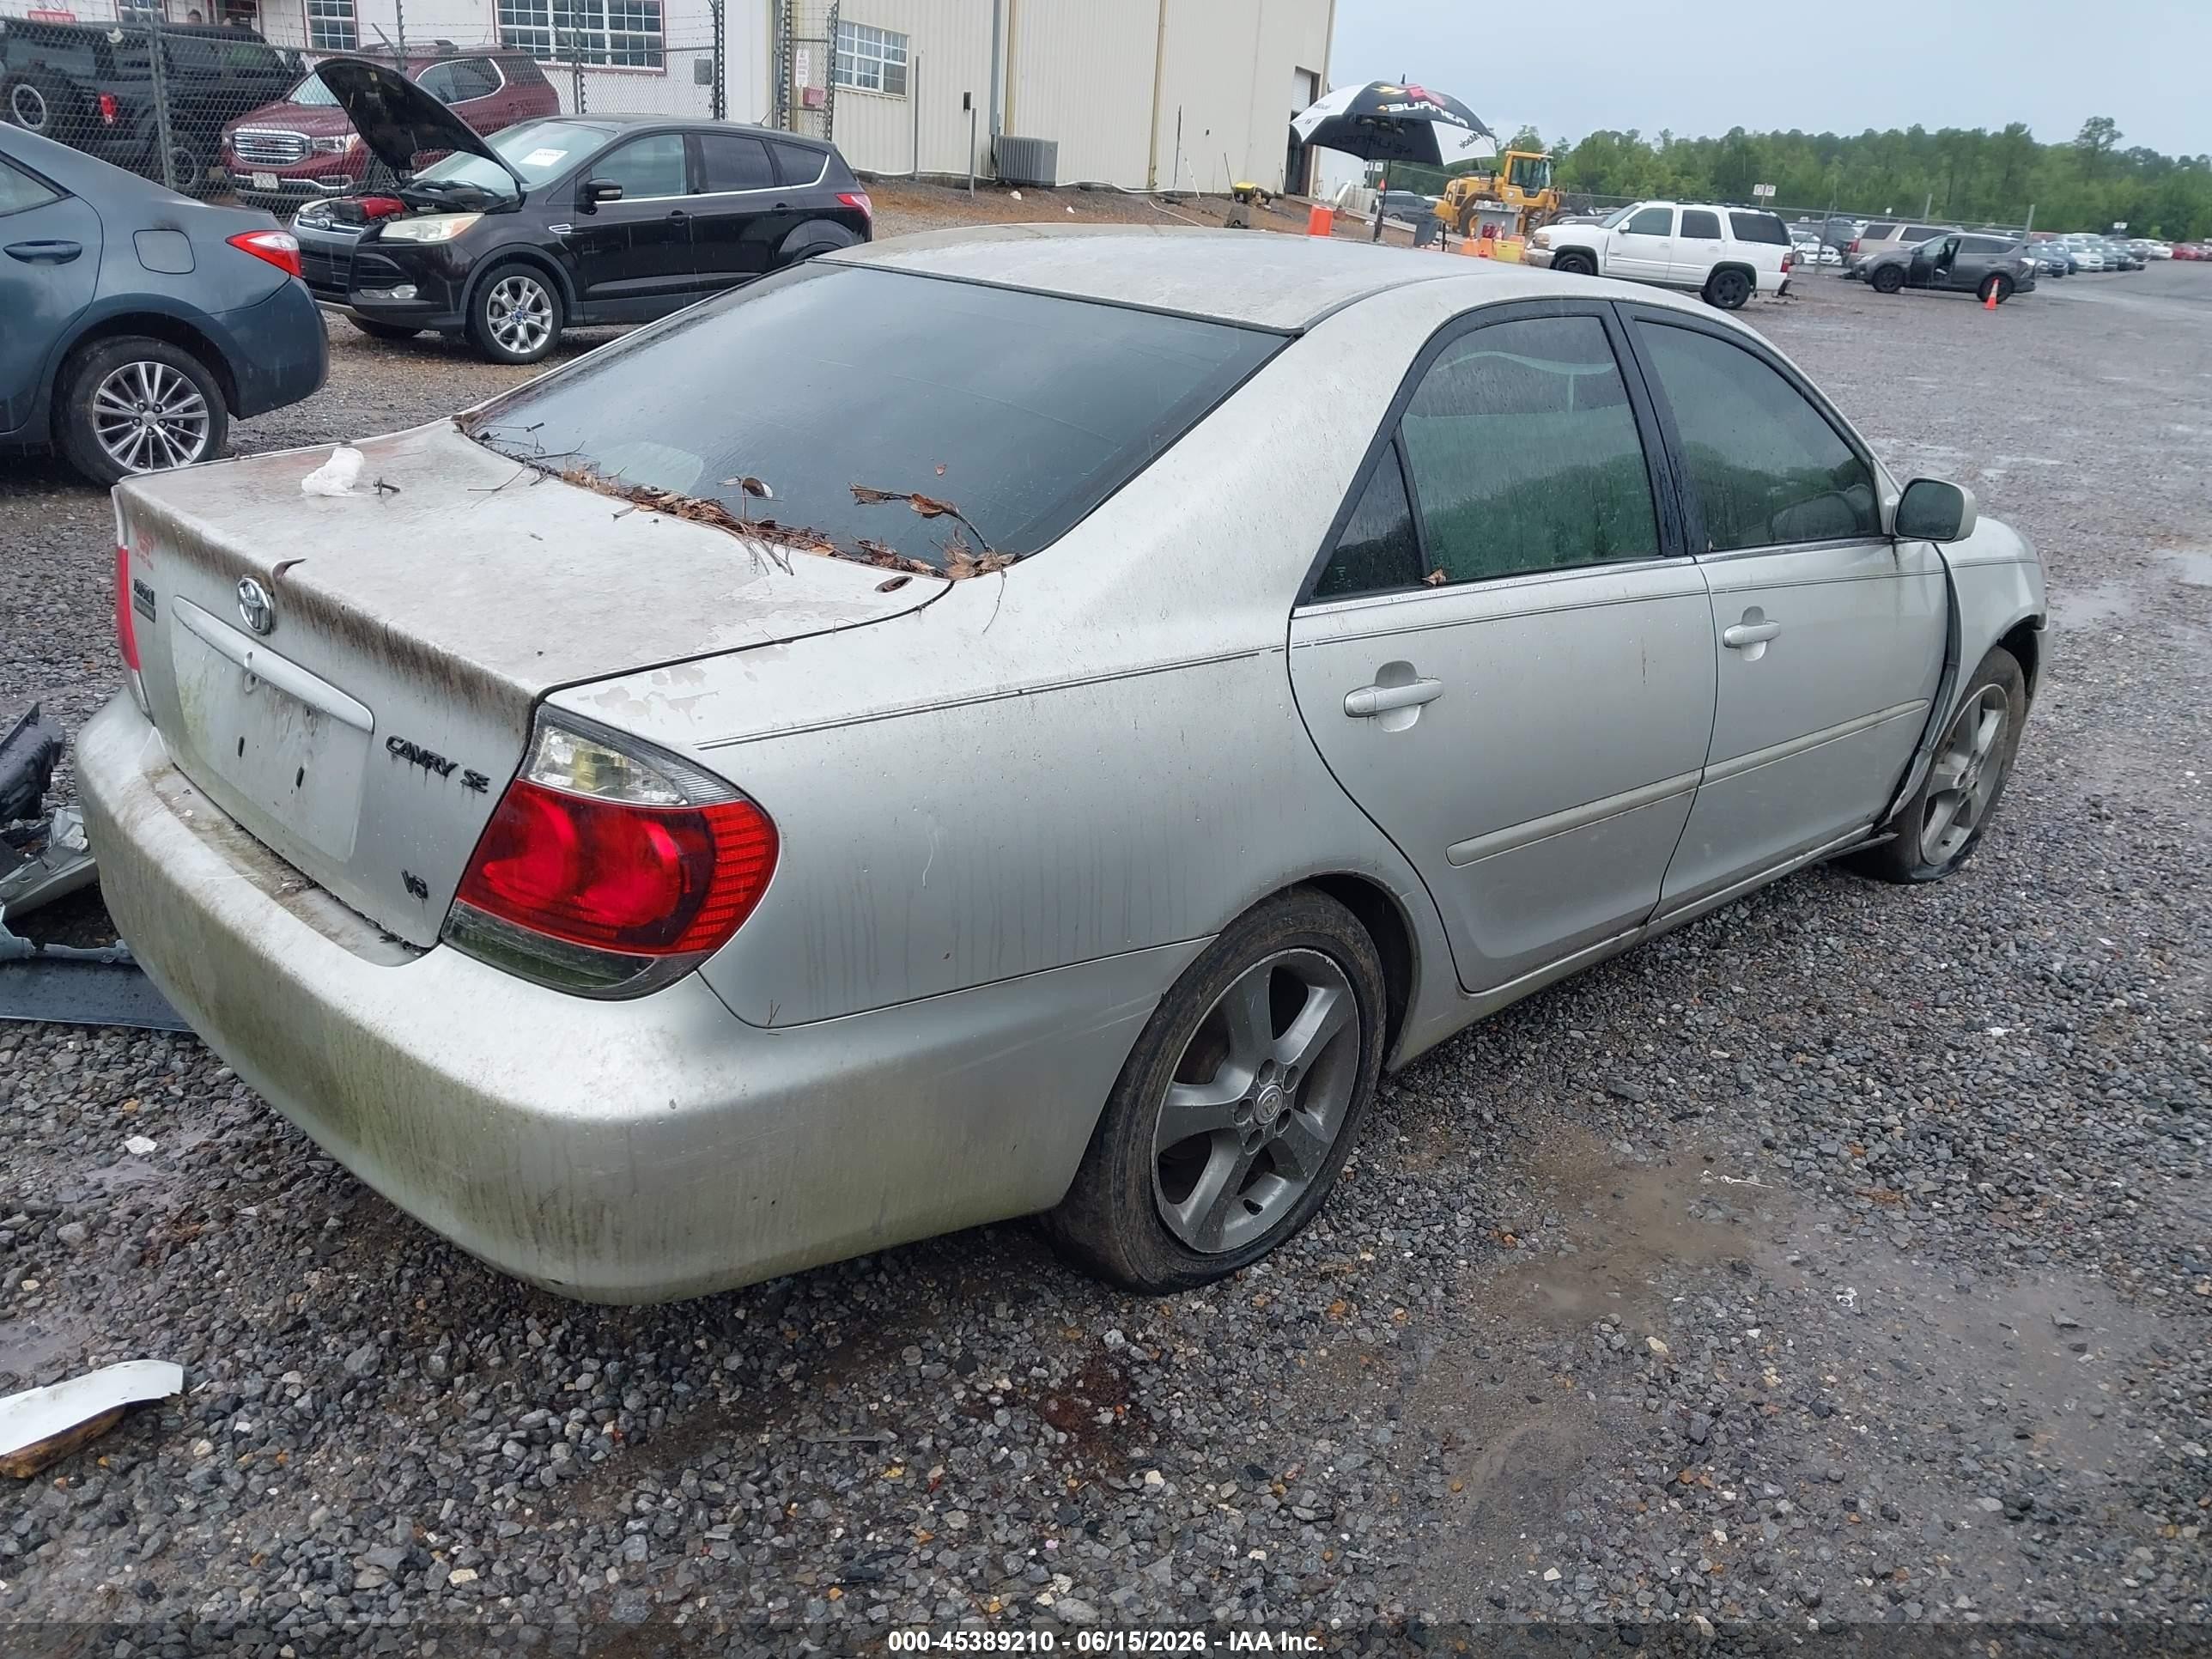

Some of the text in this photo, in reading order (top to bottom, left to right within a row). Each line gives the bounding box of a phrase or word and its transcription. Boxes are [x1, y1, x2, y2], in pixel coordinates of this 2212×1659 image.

[1386, 100, 1469, 128] BURNER
[386, 735, 490, 793] CAMRY SE
[401, 869, 428, 899] V6
